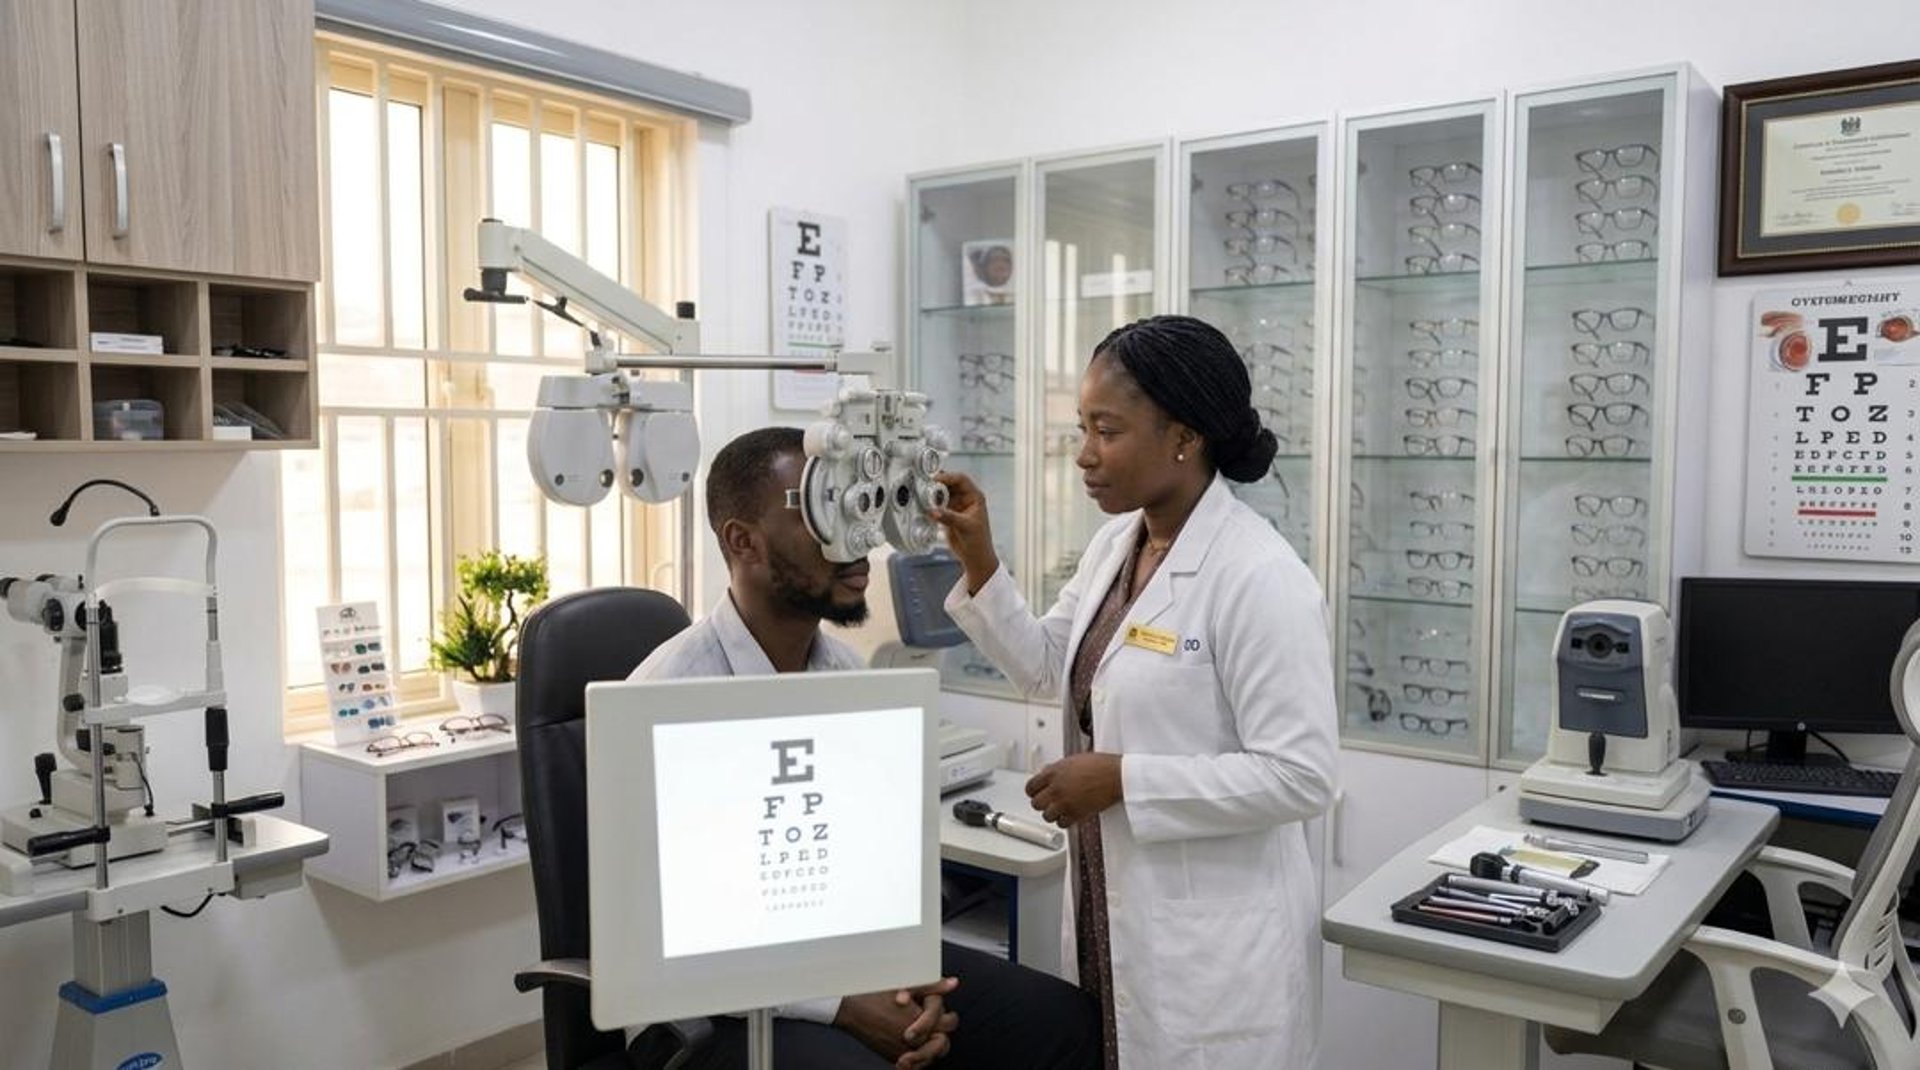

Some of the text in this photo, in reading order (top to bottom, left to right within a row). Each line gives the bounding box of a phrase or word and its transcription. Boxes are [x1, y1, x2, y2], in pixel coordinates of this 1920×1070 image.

[797, 220, 821, 257] E
[1818, 316, 1869, 362] E
[770, 739, 814, 785] E
